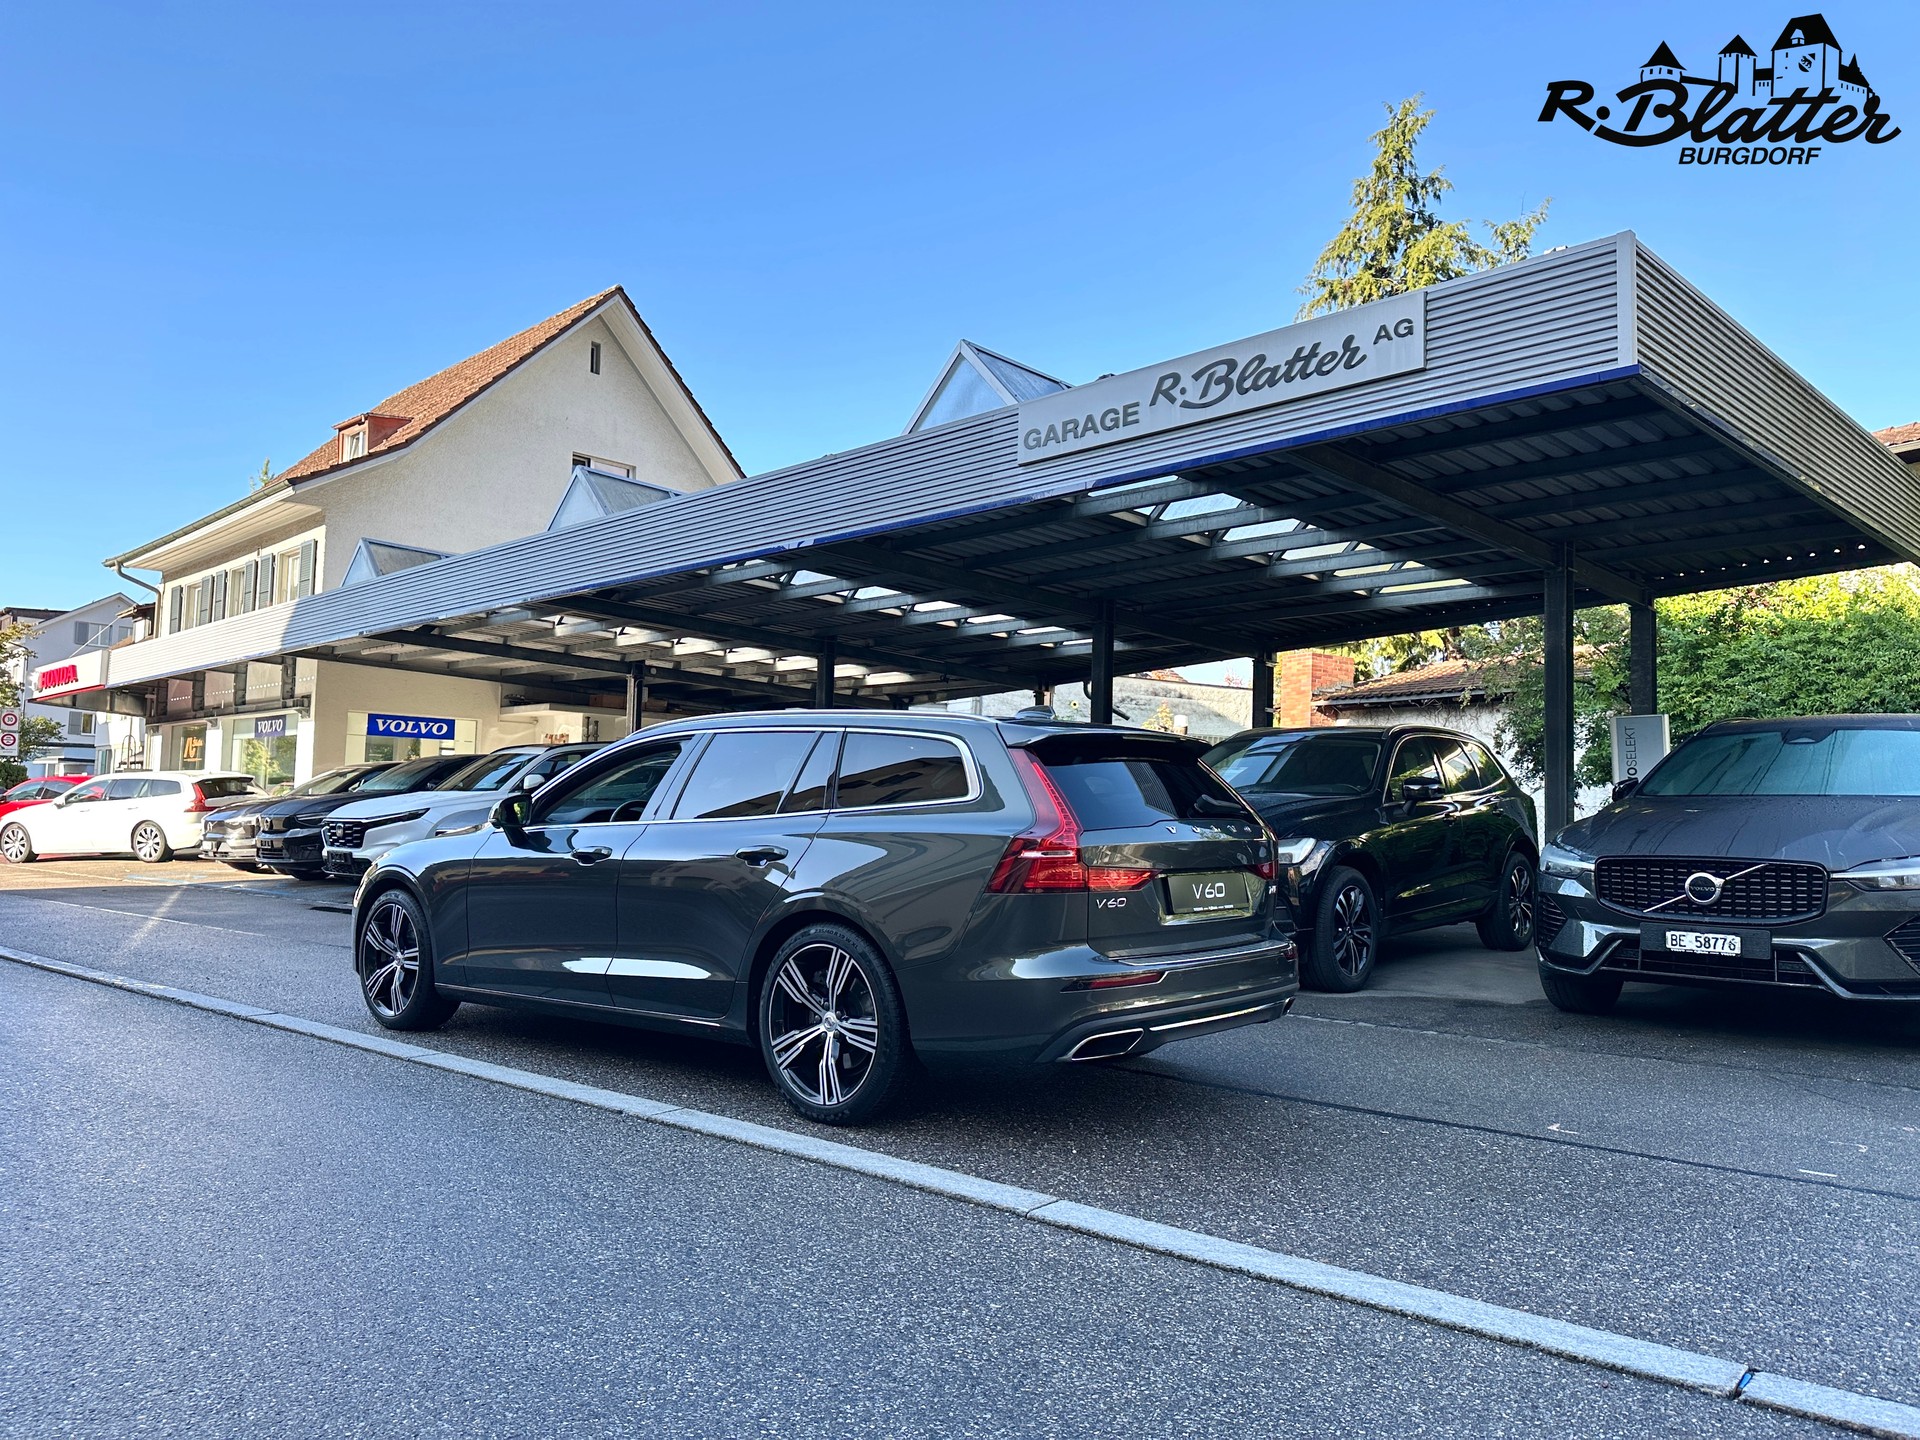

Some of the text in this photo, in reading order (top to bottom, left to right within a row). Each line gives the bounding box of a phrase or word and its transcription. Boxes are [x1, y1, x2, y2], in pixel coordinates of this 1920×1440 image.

[1023, 401, 1140, 450] GARAGE
[1373, 318, 1414, 345] AG
[39, 665, 78, 689] HONDA
[257, 719, 283, 733] VOLVO
[376, 719, 448, 735] VOLVO
[1192, 882, 1226, 900] V60
[1096, 897, 1127, 909] V60
[1670, 934, 1686, 948] BE
